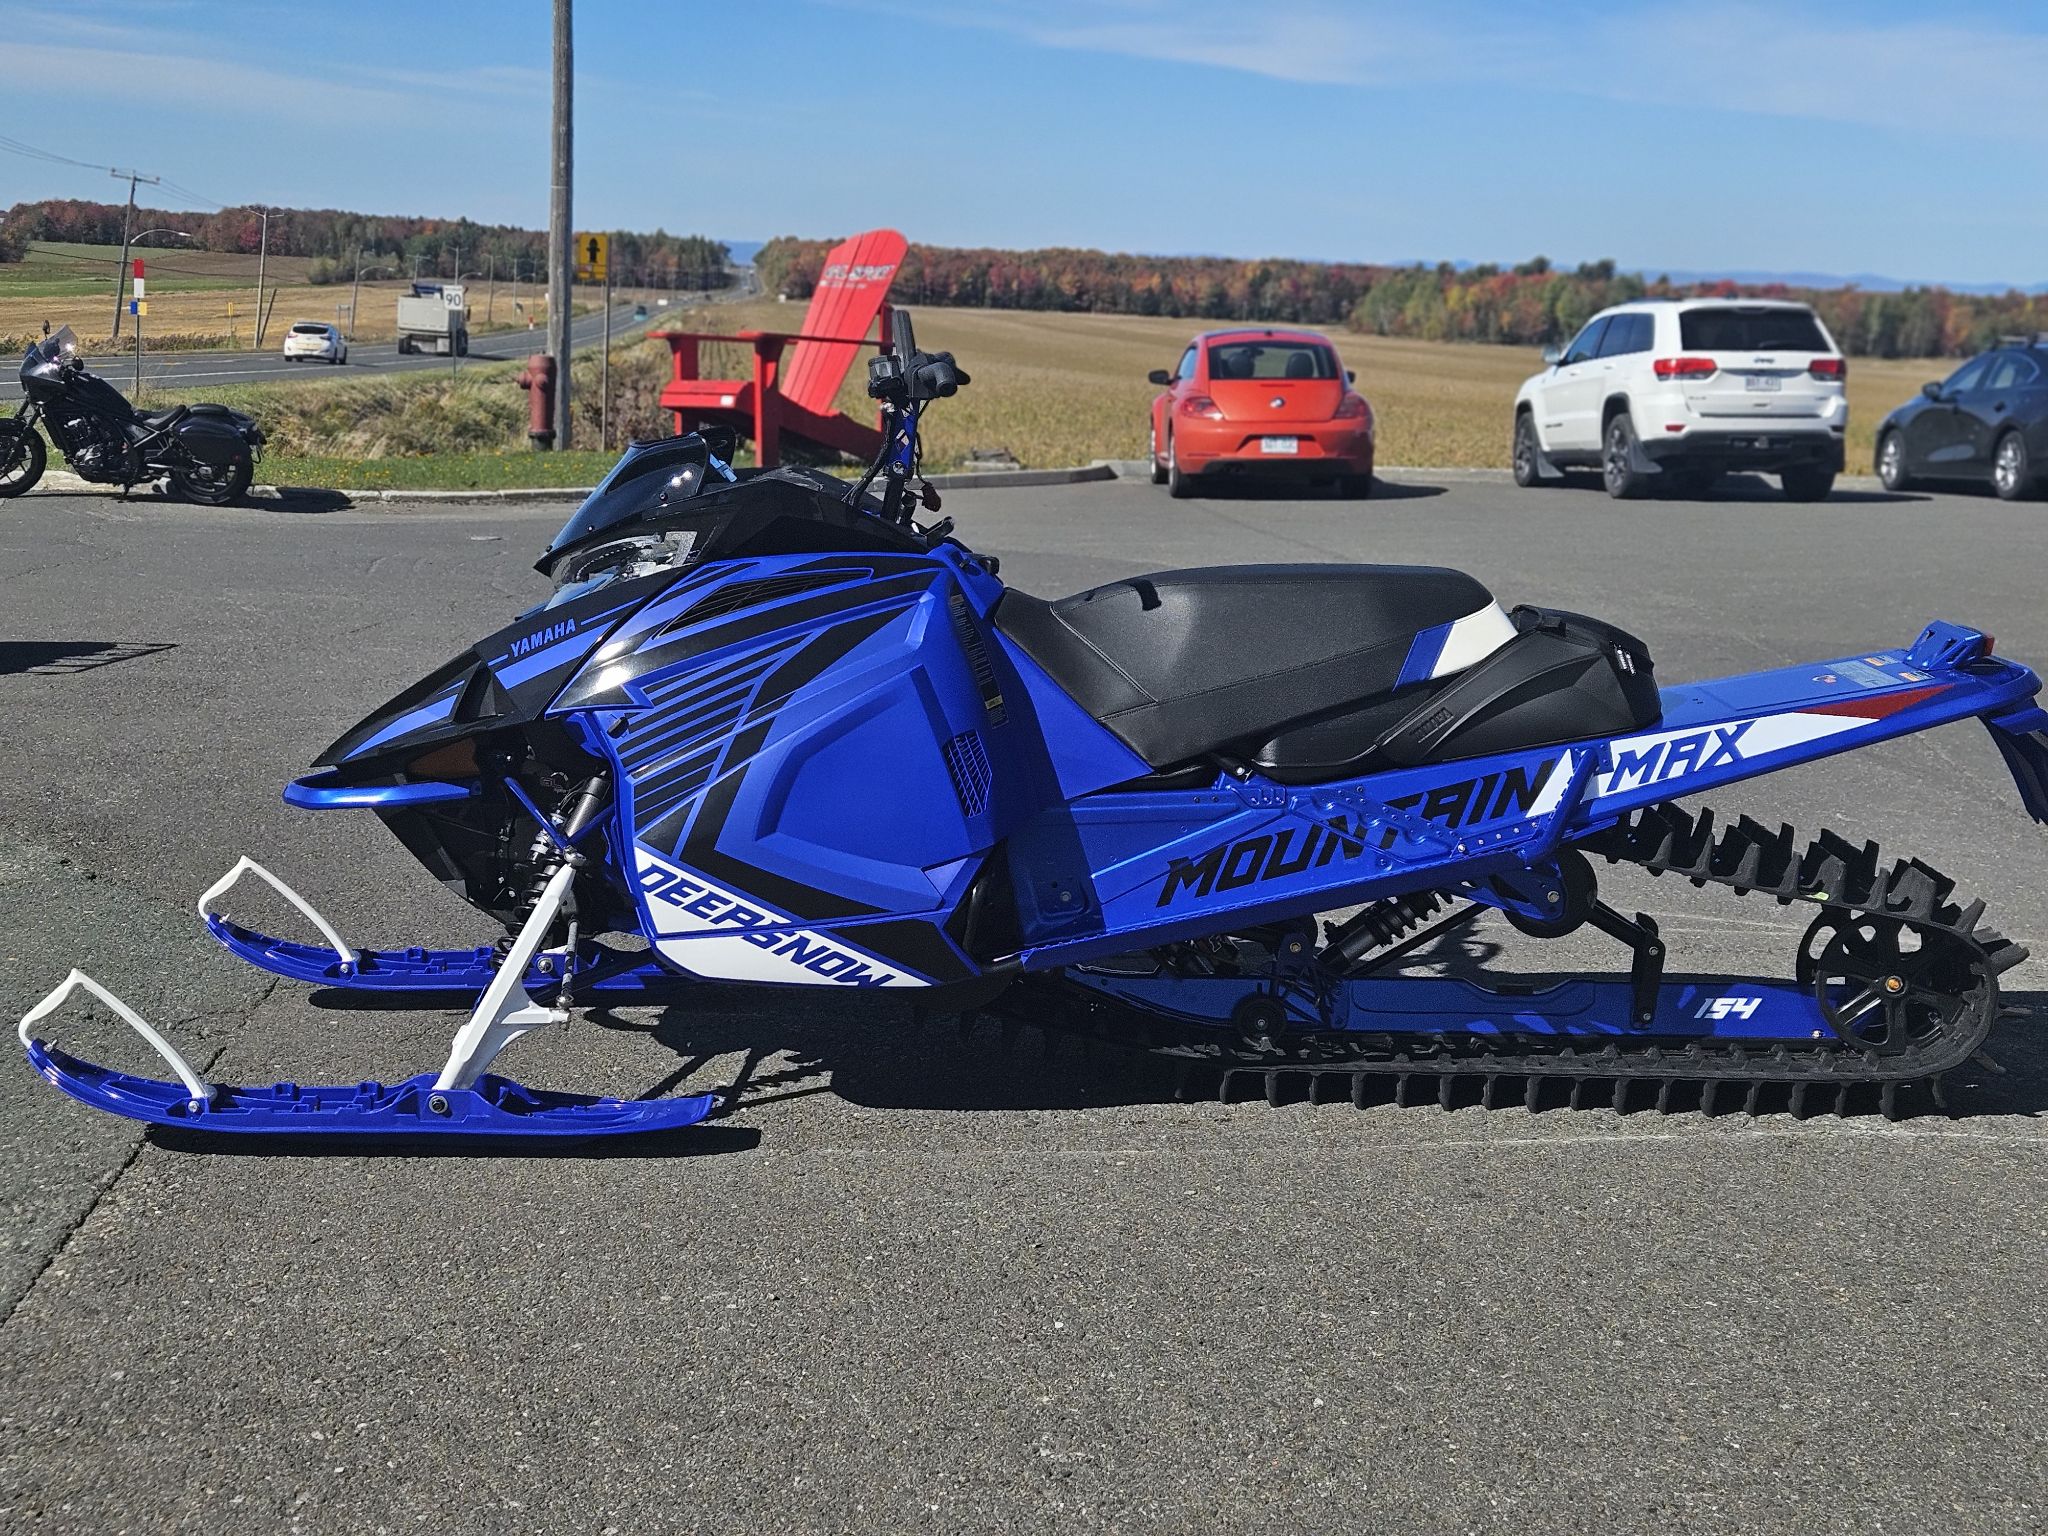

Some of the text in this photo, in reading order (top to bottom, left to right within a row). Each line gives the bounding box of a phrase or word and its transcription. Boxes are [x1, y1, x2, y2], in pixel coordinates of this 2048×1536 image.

[445, 293, 462, 307] 90
[510, 618, 577, 658] YAMAHA
[1604, 719, 1759, 793] MAX
[638, 863, 898, 988] DEEPSNOW
[1693, 997, 1763, 1020] 154
